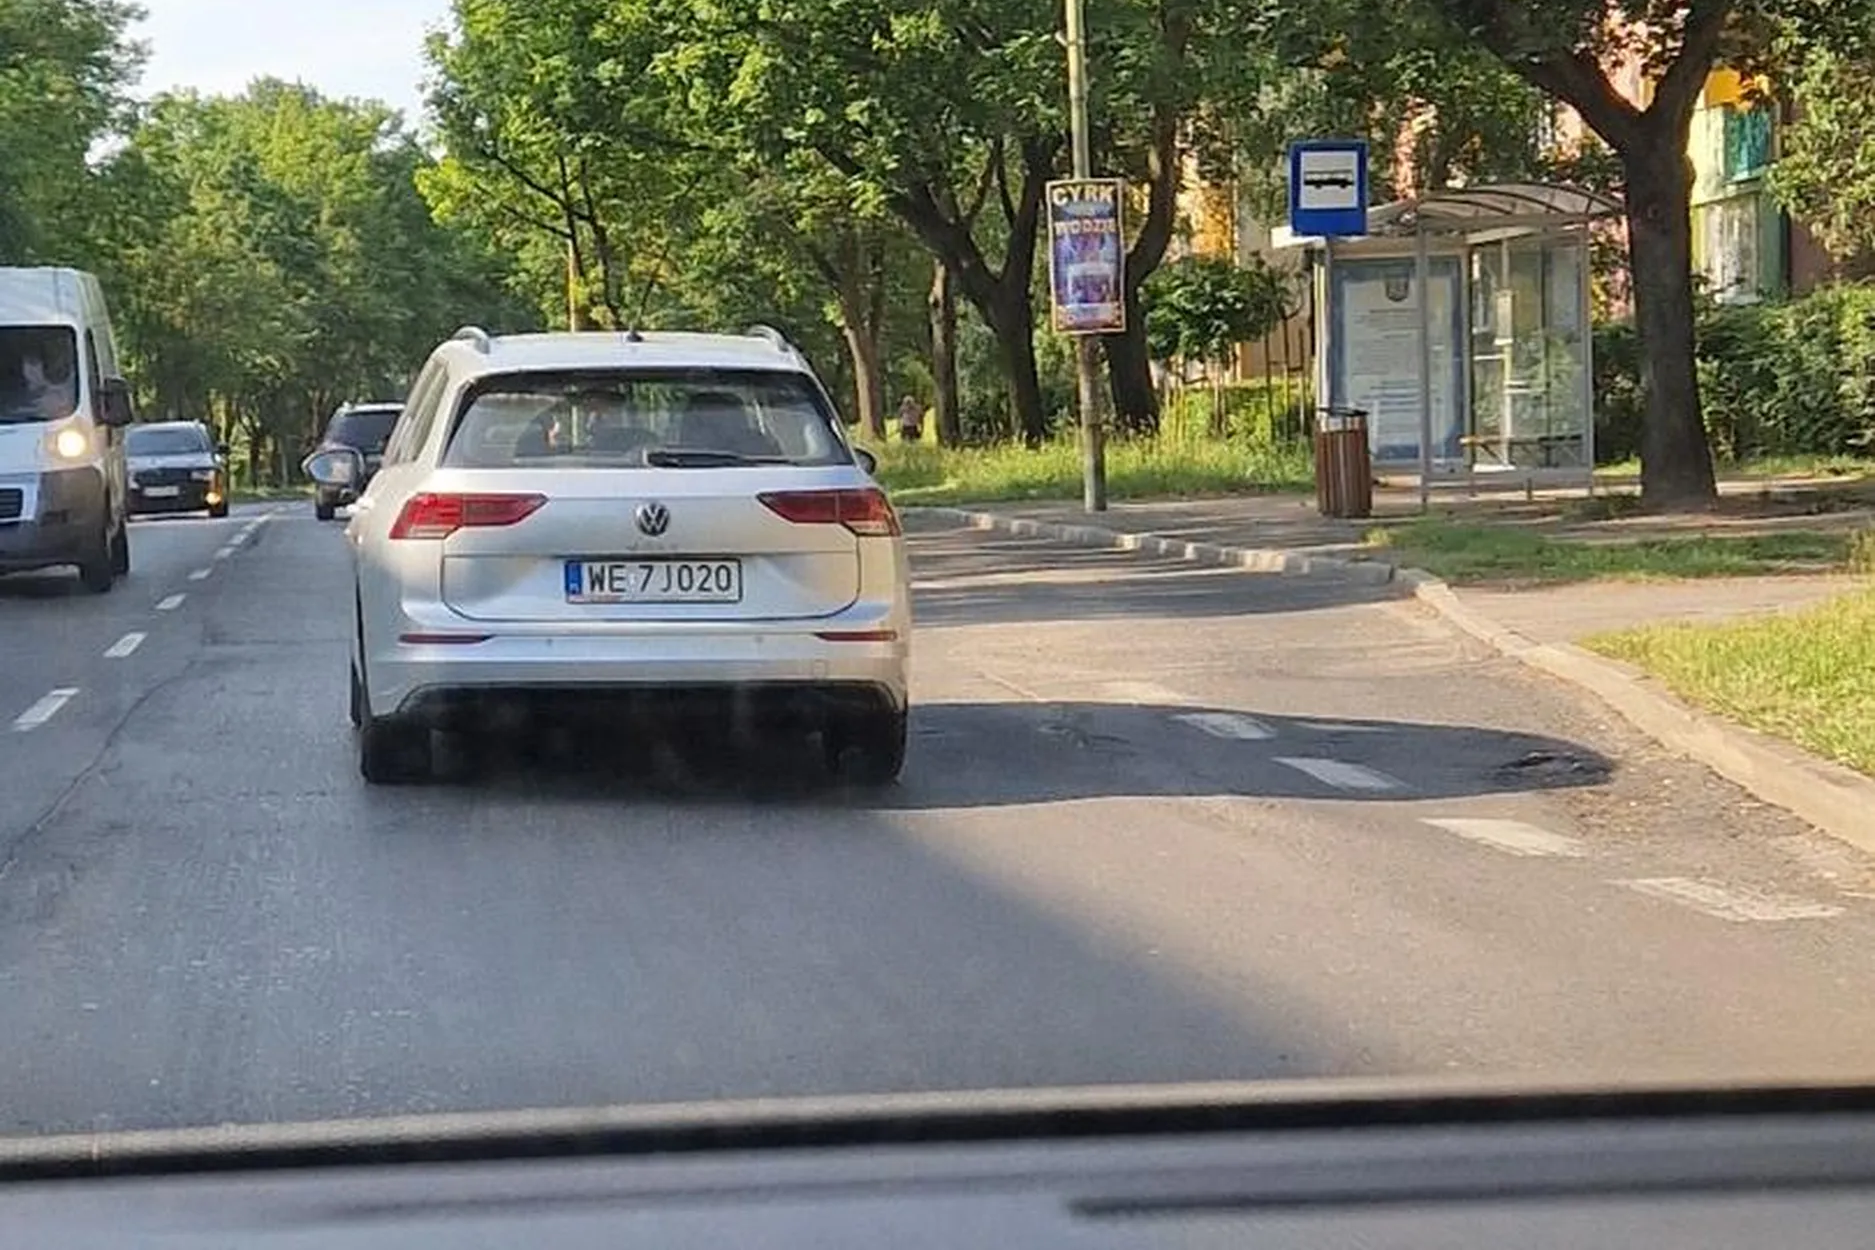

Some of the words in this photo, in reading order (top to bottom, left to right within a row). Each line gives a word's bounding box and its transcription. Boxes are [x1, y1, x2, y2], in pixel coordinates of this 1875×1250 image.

[1053, 185, 1114, 206] CYRK
[588, 564, 626, 592] WE
[638, 564, 732, 592] 7J020
